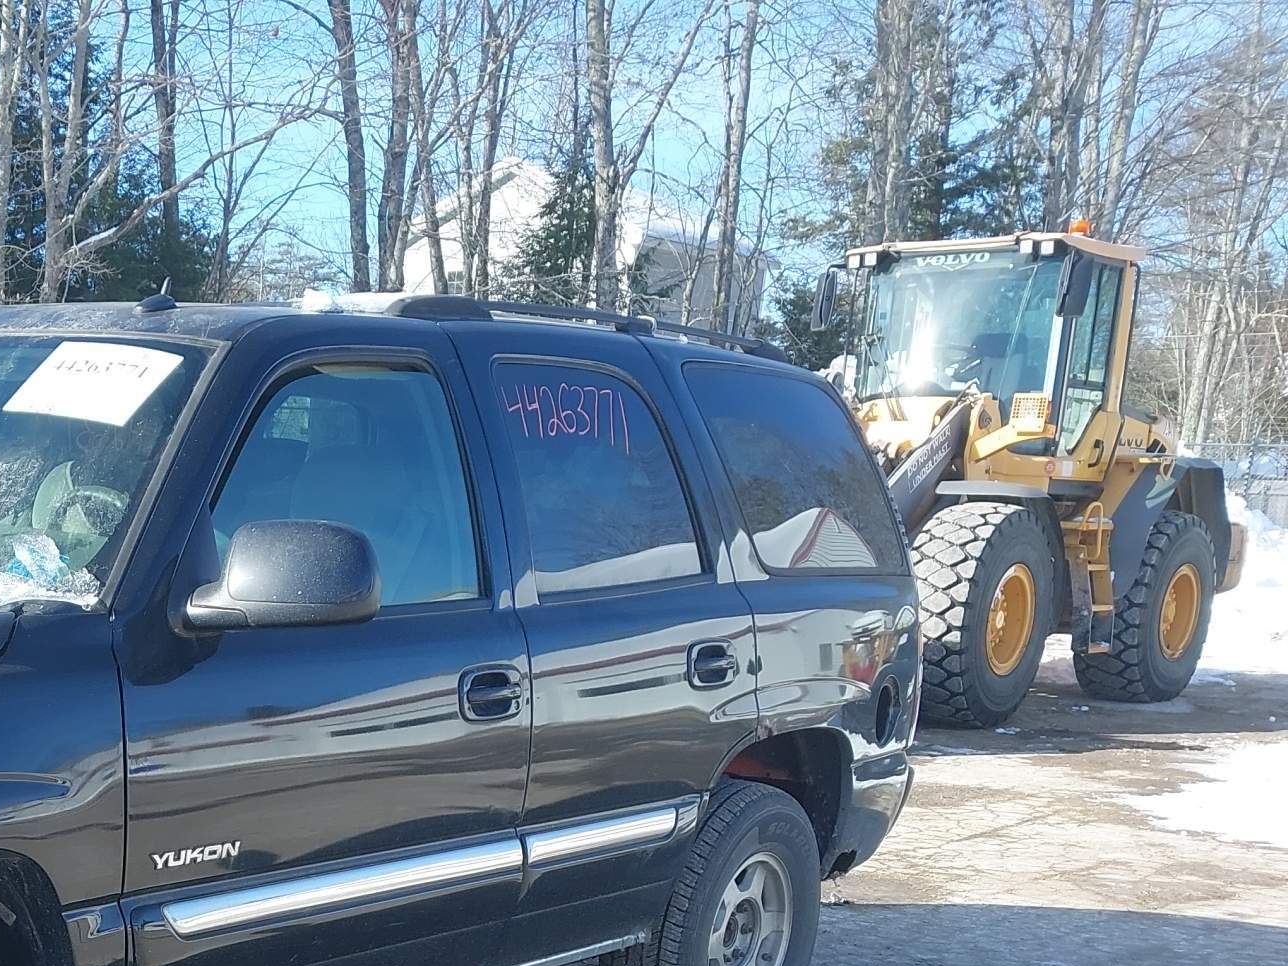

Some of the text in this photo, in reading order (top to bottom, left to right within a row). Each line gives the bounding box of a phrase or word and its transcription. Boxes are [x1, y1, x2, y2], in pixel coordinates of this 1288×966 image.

[914, 251, 991, 267] VOLVO
[500, 382, 630, 456] 44263771
[150, 840, 242, 870] YUKON
